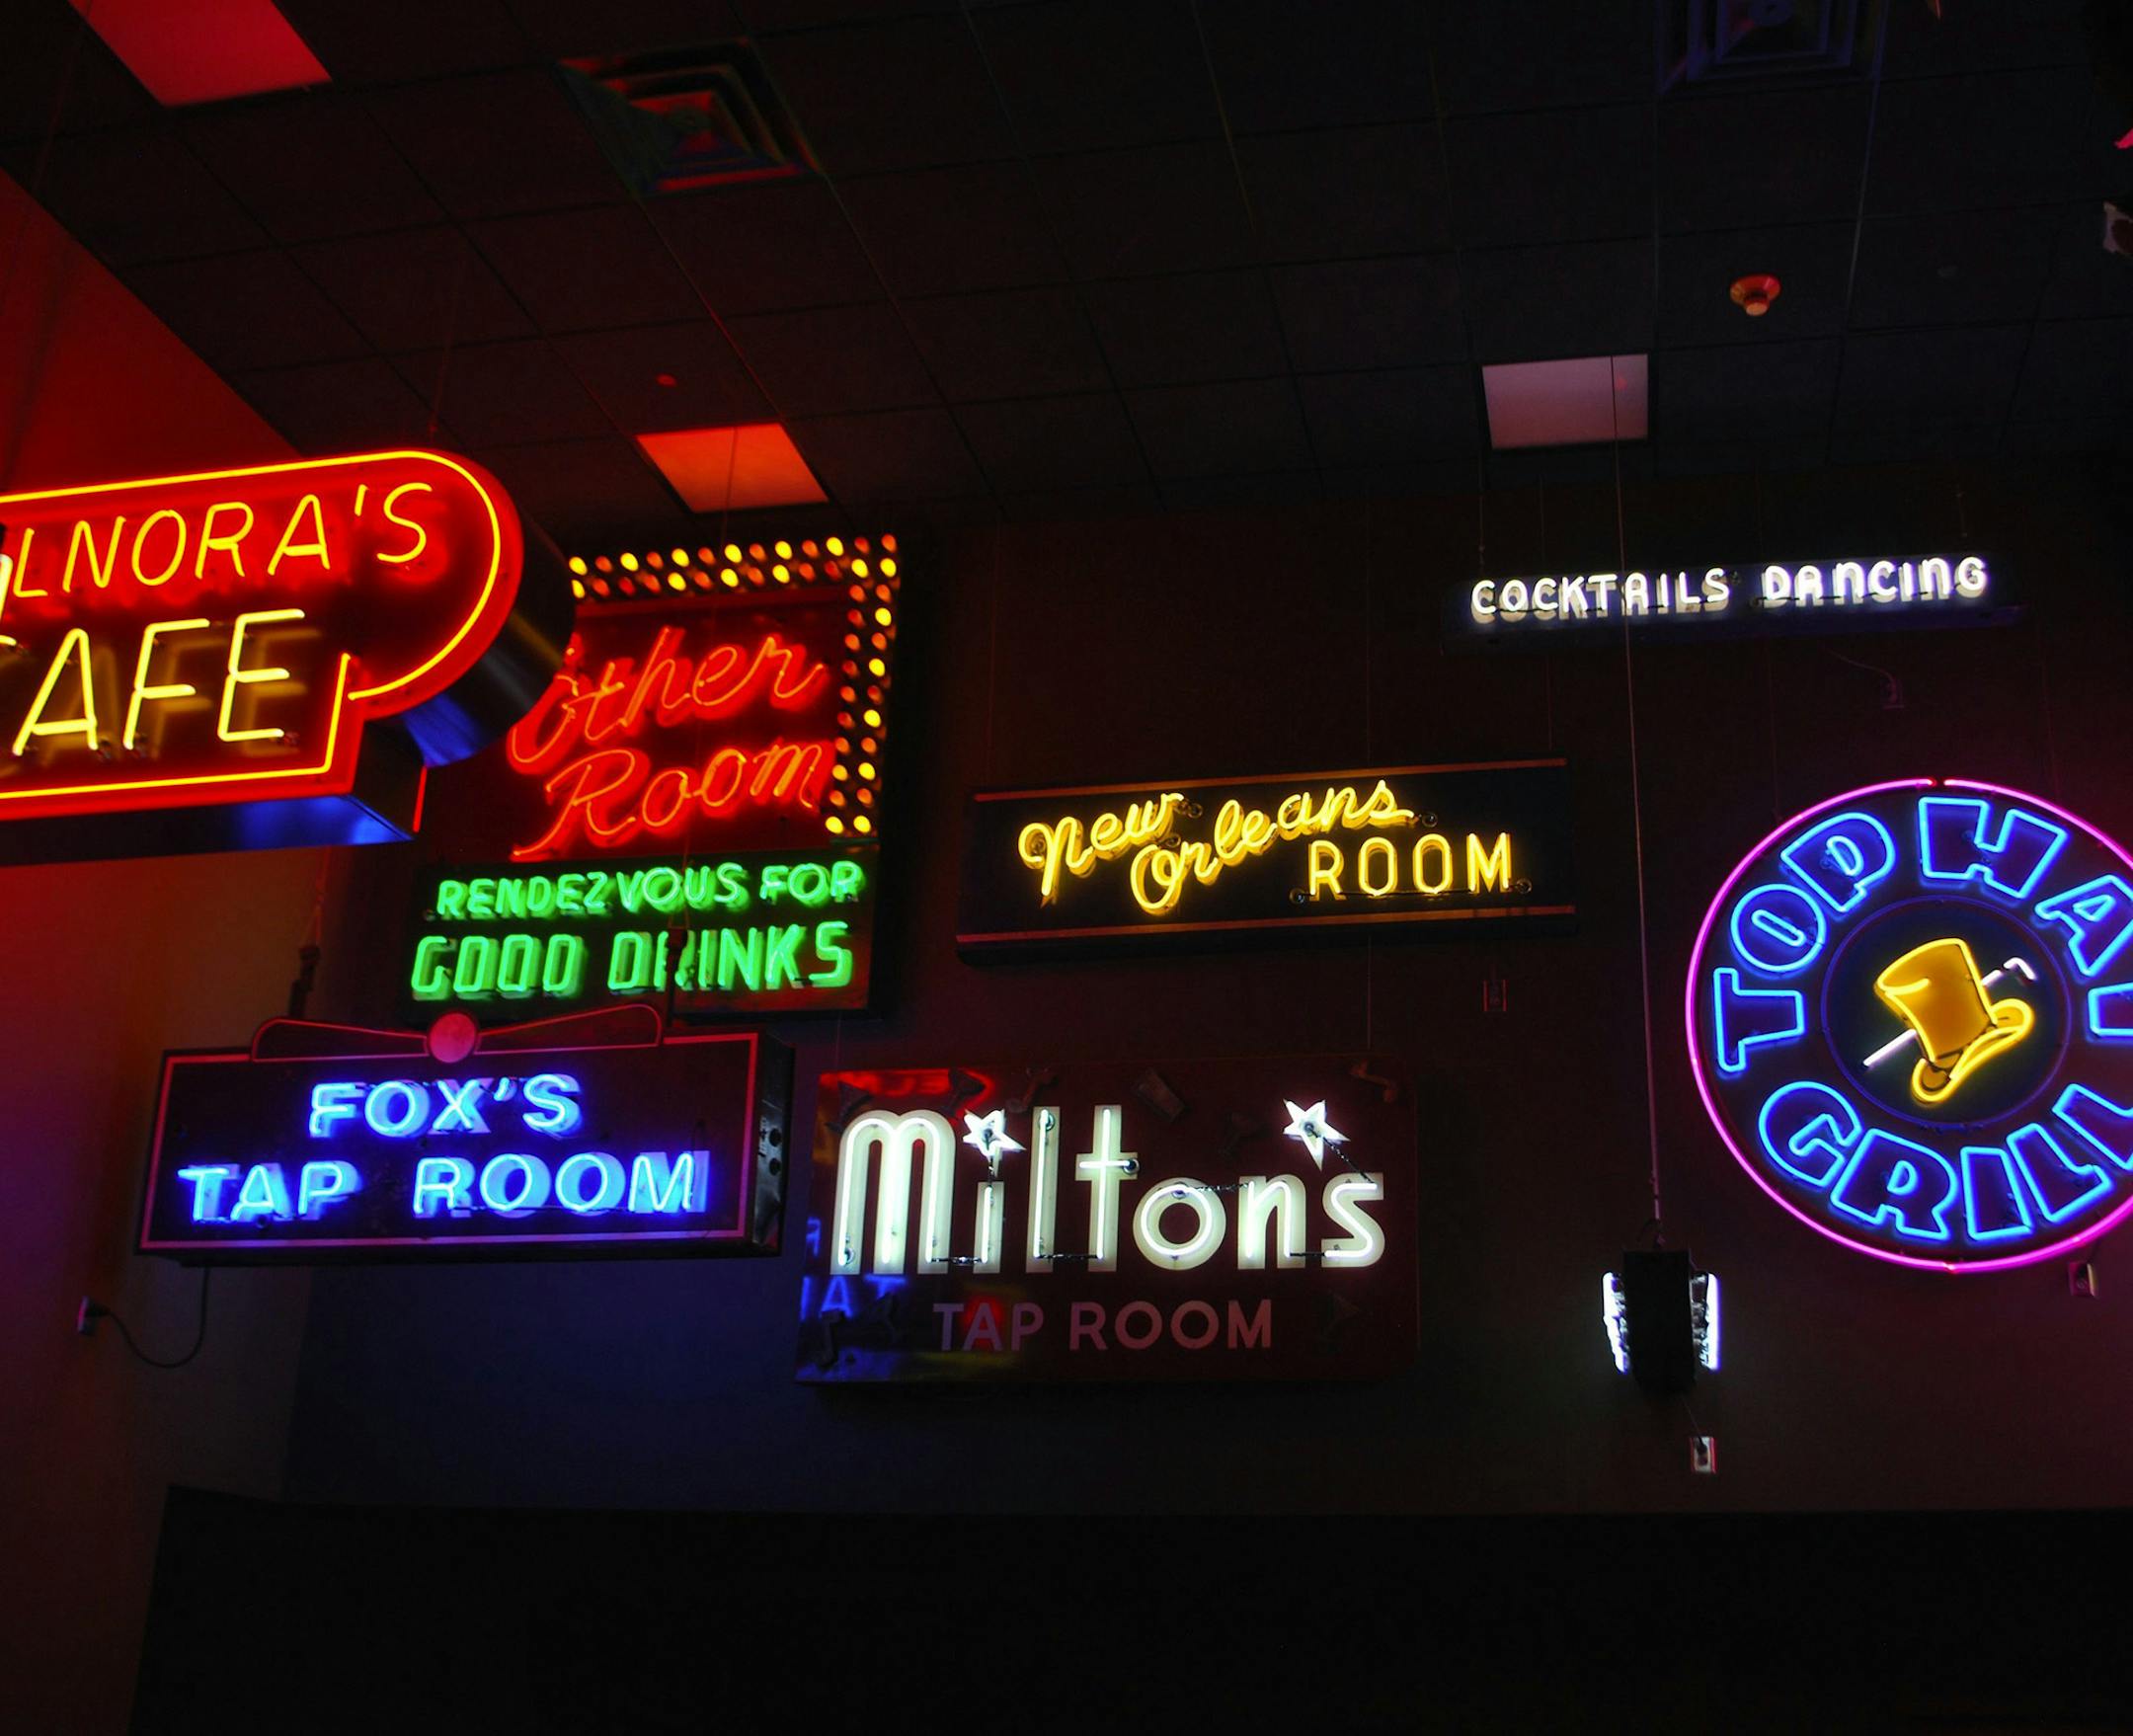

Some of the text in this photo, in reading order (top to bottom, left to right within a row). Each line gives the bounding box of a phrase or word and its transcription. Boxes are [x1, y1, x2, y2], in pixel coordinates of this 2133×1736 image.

[1470, 556, 1988, 624] COCKTAILS DANCING
[0, 607, 306, 756] AFE
[510, 739, 835, 861] Room
[758, 859, 863, 905] FOR
[1128, 779, 1515, 916] Orleans ROOM
[411, 932, 583, 1000] GOOD
[1712, 812, 1898, 1072] TOP
[309, 1073, 585, 1140] FOX'S
[178, 1149, 709, 1223] TAP ROOM
[932, 1298, 1273, 1352] TAP ROOM
